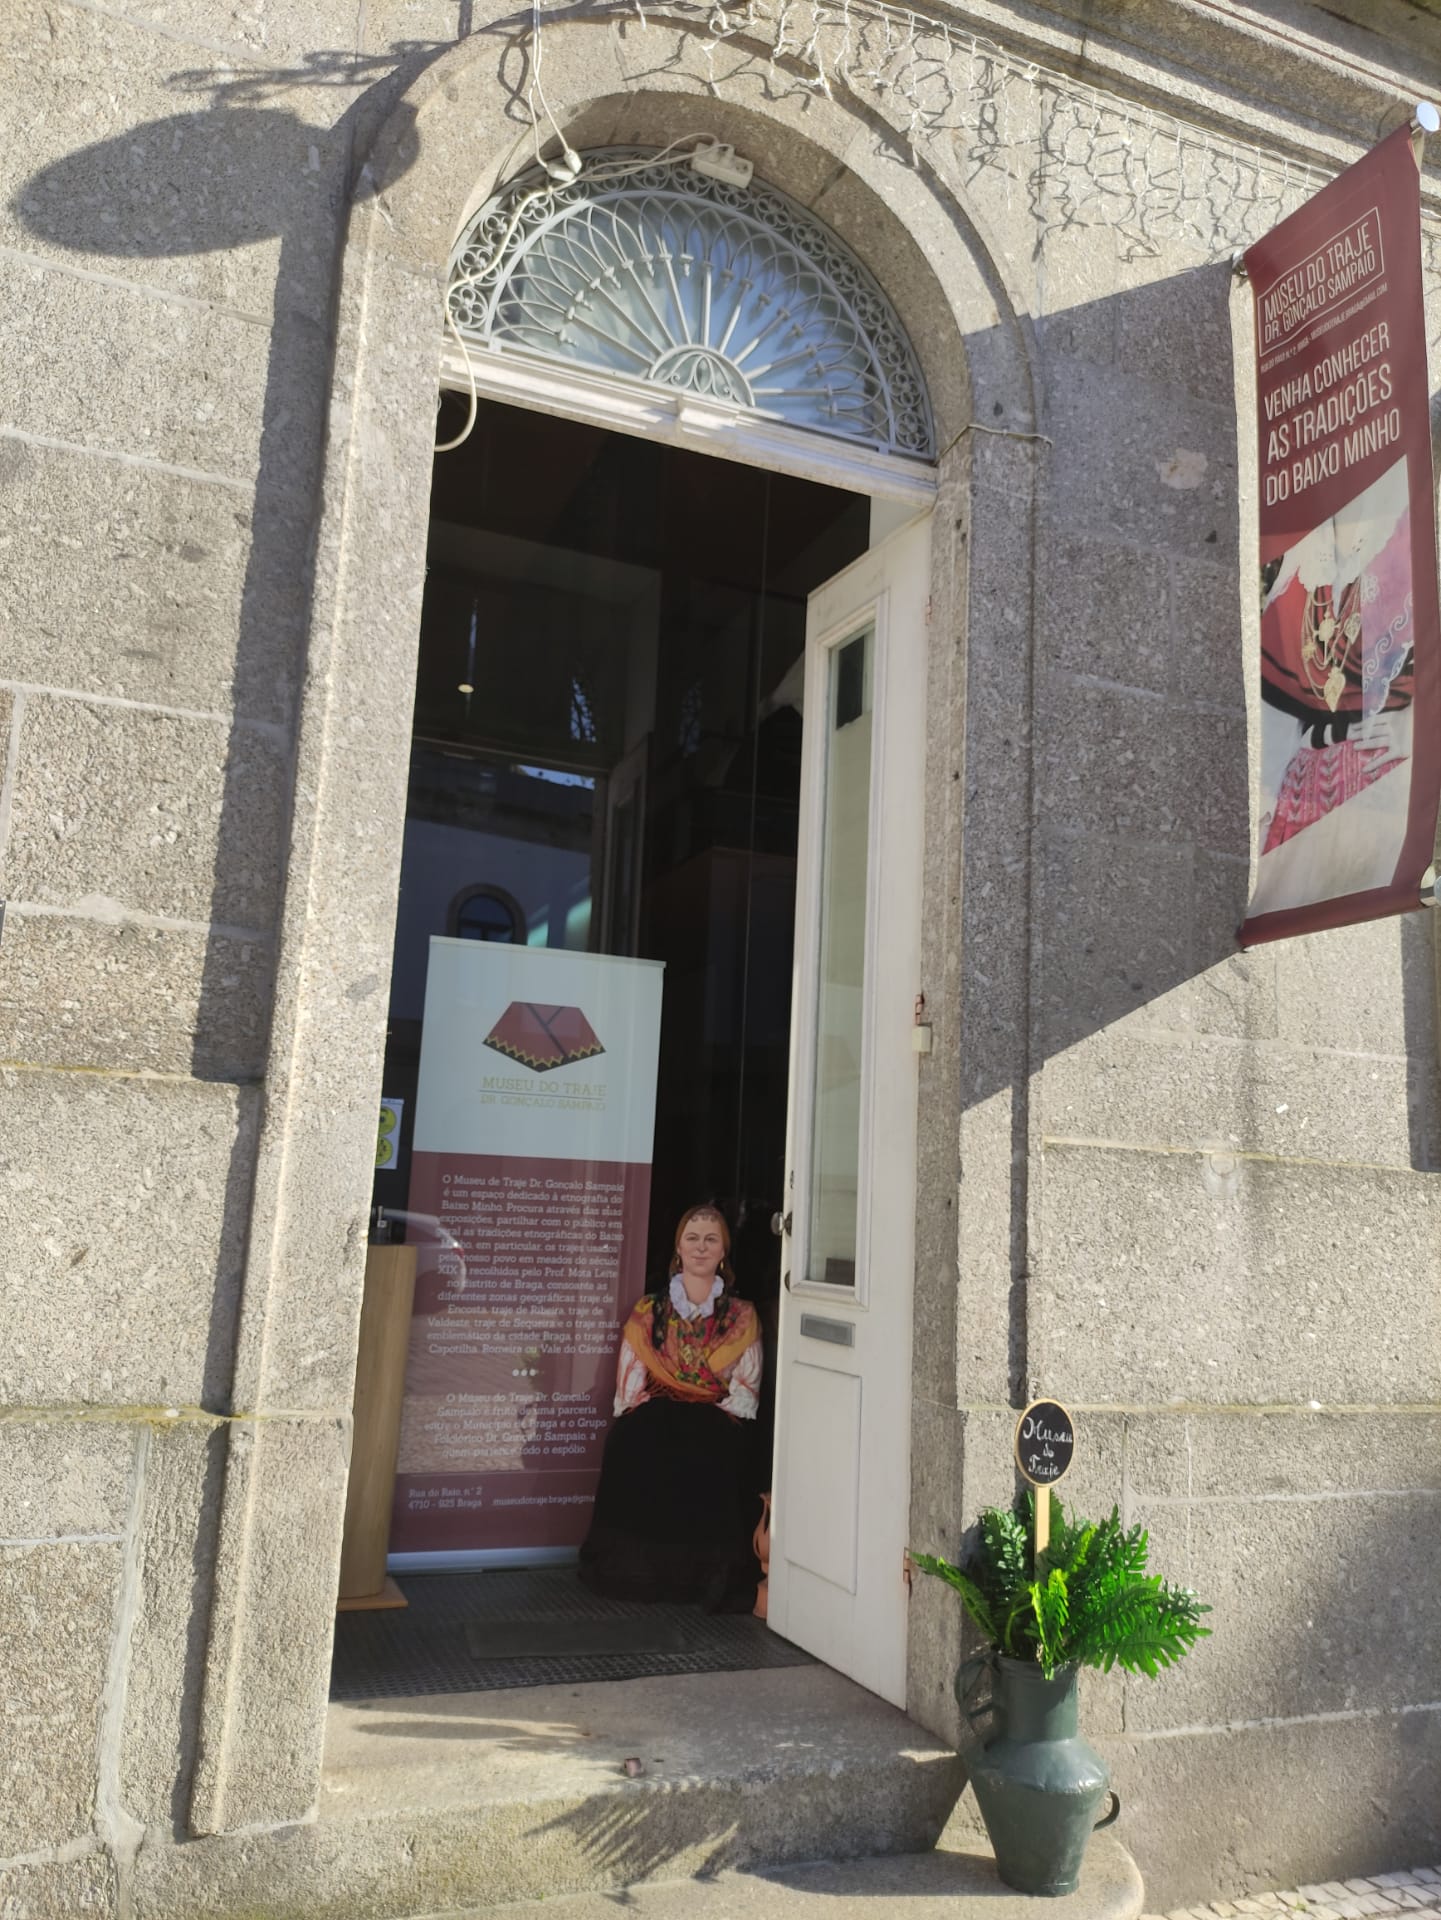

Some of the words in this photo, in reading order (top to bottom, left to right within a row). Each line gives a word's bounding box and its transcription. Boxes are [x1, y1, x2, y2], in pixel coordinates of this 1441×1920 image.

[1264, 270, 1303, 323] MUSEU
[1306, 256, 1326, 289] DO
[1326, 222, 1373, 274] TRAJE
[1264, 320, 1282, 344] DR.
[1282, 285, 1326, 332] GONÇALO
[1327, 250, 1376, 299] SAMPAIO
[1264, 373, 1312, 421] VENHA
[1313, 321, 1390, 394] CONHECER
[1267, 423, 1290, 464] AS
[1293, 363, 1393, 449] TRADIÇÕES
[1266, 470, 1289, 506] DO
[1293, 443, 1340, 494] BAIXO
[1344, 408, 1400, 468] MINHO
[481, 1077, 534, 1091] MUSEU
[538, 1080, 559, 1093] DO
[562, 1082, 607, 1097] TRAJE
[442, 1174, 451, 1184] O
[453, 1175, 486, 1186] Museu
[502, 1177, 528, 1189] Traje
[545, 1179, 584, 1190] Gonçalo
[585, 1181, 625, 1192] Sampaio
[443, 1187, 450, 1197] é
[452, 1190, 468, 1198] um
[470, 1191, 505, 1200] espaço
[506, 1190, 550, 1200] dedicado
[560, 1194, 608, 1204] etnografia
[610, 1194, 623, 1204] do
[441, 1200, 470, 1210] Baixo
[506, 1202, 544, 1213] Procura
[546, 1205, 580, 1215] através
[583, 1205, 599, 1215] das
[601, 1207, 623, 1216] suas
[496, 1216, 540, 1227] partilhar
[541, 1218, 561, 1227] com
[563, 1219, 571, 1227] o
[572, 1217, 606, 1229] público
[608, 1221, 623, 1229] em
[477, 1227, 522, 1239] tradições
[524, 1228, 583, 1241] etnográficas
[585, 1231, 597, 1240] do
[599, 1231, 624, 1242] Baixo
[475, 1242, 492, 1250] em
[544, 1244, 556, 1252] os
[463, 1254, 491, 1263] nosso
[492, 1255, 517, 1265] povo
[518, 1256, 534, 1264] em
[536, 1254, 572, 1264] meados
[589, 1255, 618, 1266] século
[469, 1265, 519, 1276] recolhidos
[521, 1267, 542, 1278] pelo
[568, 1268, 592, 1278] Mota
[499, 1279, 512, 1289] de
[546, 1281, 594, 1290] consoante
[596, 1283, 608, 1291] as
[437, 1291, 487, 1301] diferentes
[488, 1294, 518, 1302] zonas
[579, 1294, 600, 1305] traje
[602, 1293, 615, 1303] de
[491, 1306, 514, 1316] traje
[515, 1305, 528, 1314] de
[568, 1306, 590, 1318] traje
[591, 1306, 604, 1316] de
[474, 1318, 497, 1329] traje
[498, 1318, 511, 1328] de
[565, 1320, 573, 1328] o
[575, 1319, 596, 1331] traje
[597, 1319, 620, 1329] mais
[574, 1333, 581, 1341] o
[583, 1332, 605, 1343] traje
[607, 1331, 619, 1341] de
[540, 1343, 562, 1354] Vale
[563, 1343, 577, 1354] do
[446, 1392, 456, 1403] O
[551, 1391, 591, 1403] Gonçalo
[557, 1406, 597, 1417] parceria
[559, 1420, 567, 1428] e
[568, 1420, 576, 1428] o
[577, 1418, 608, 1429] Grupo
[1023, 1416, 1072, 1443] Museu
[543, 1447, 550, 1455] o
[1042, 1442, 1054, 1458] do
[1028, 1454, 1061, 1479] Traje
[456, 1498, 482, 1509] Braga
